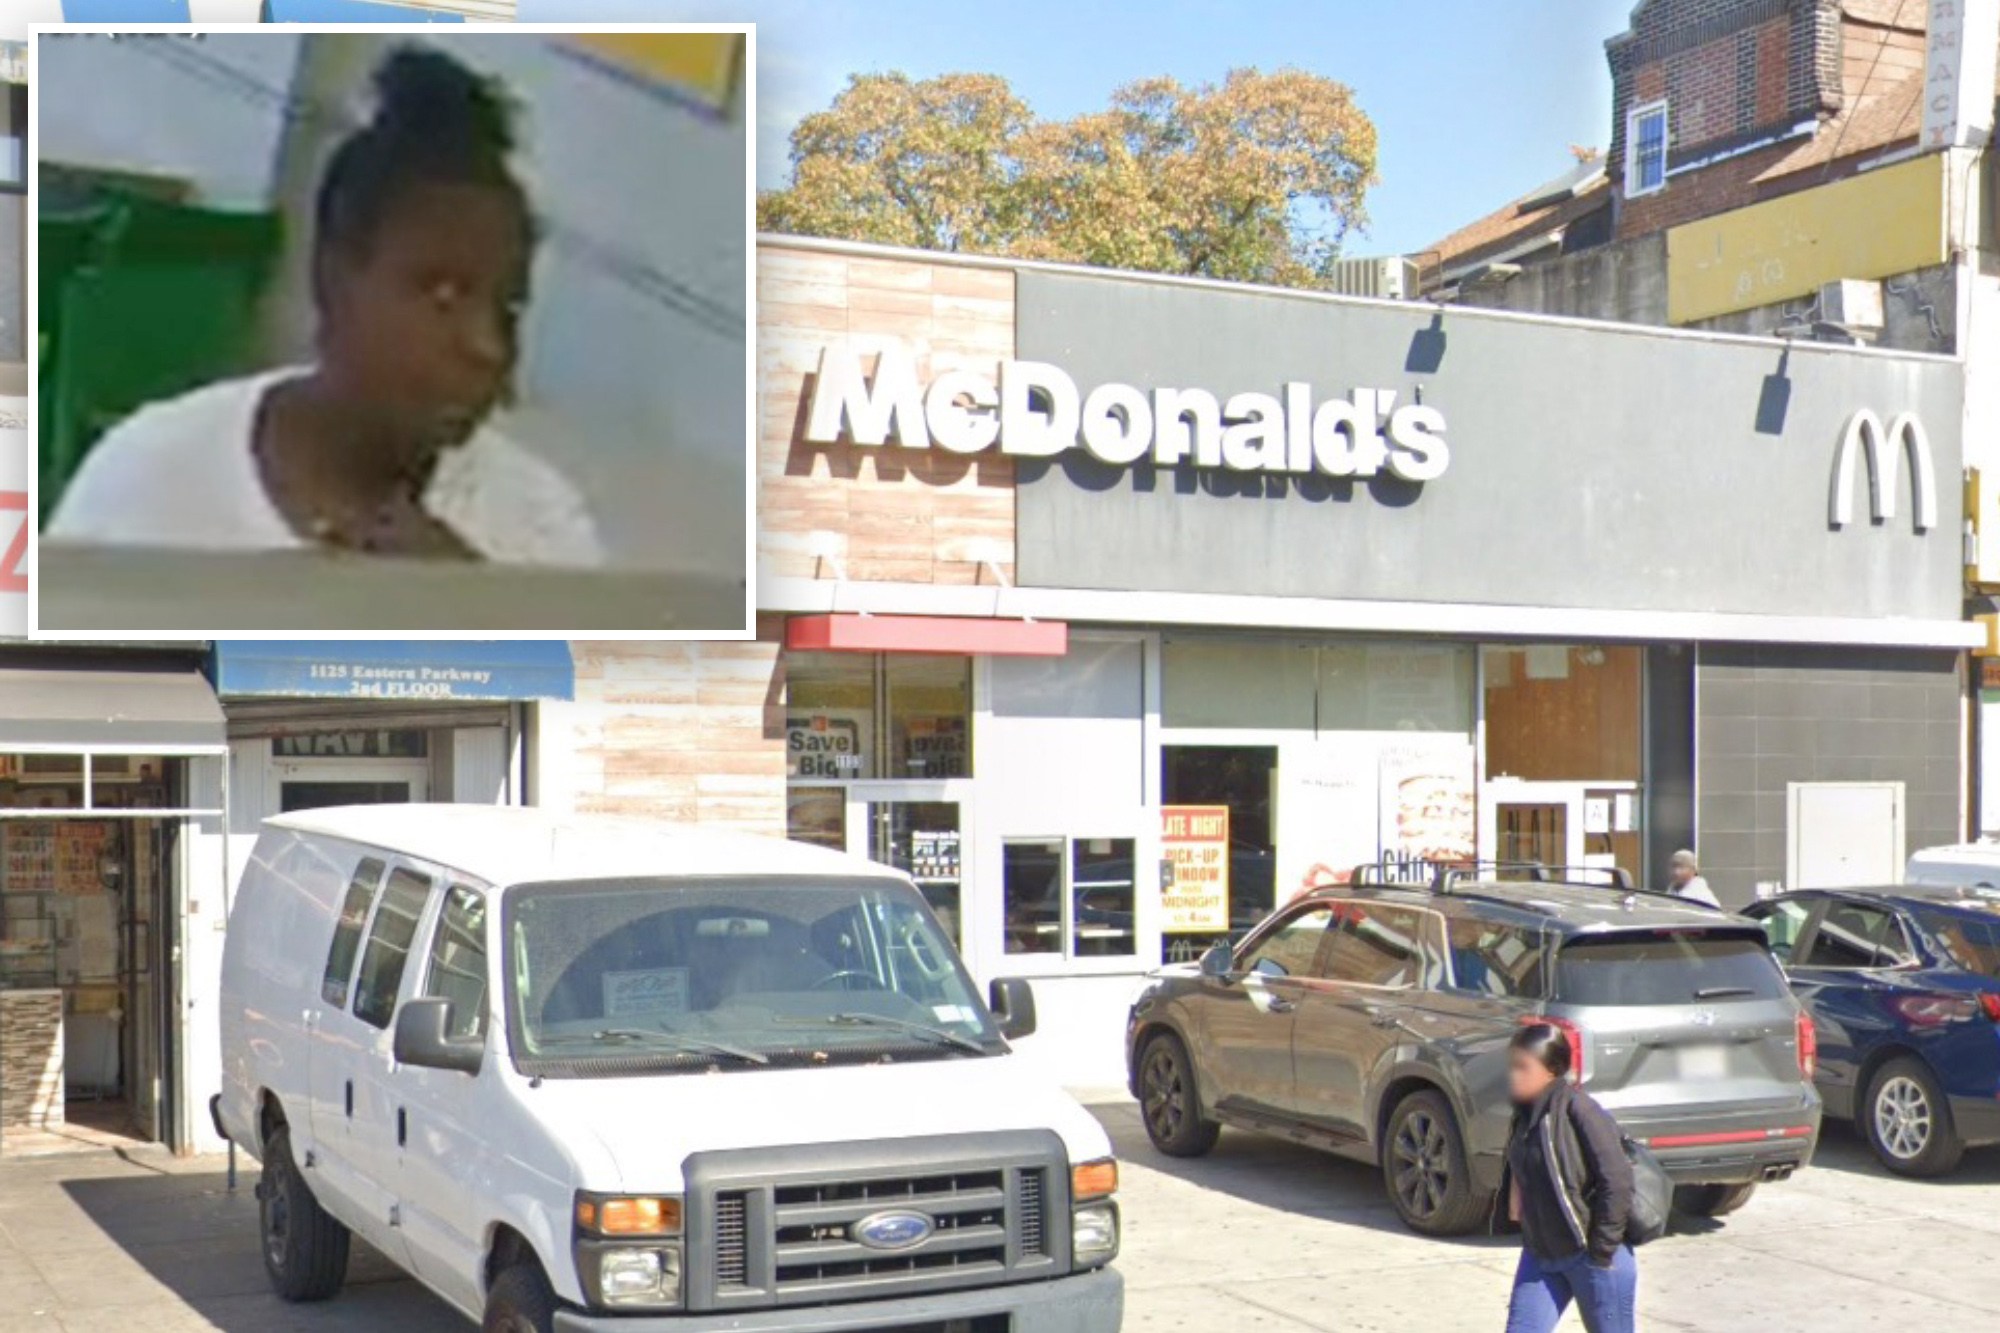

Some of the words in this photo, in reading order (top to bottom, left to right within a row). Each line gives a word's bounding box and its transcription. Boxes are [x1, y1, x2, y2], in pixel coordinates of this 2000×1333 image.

[804, 333, 1450, 480] McDonald's
[310, 664, 347, 678] 1125
[353, 665, 416, 680] Eastern
[421, 667, 491, 683] Parkway
[386, 682, 452, 697] FLOOR
[790, 731, 850, 752] Save
[800, 755, 840, 778] Big
[1190, 815, 1225, 838] NIGHT
[1164, 848, 1219, 864] PICK-UP
